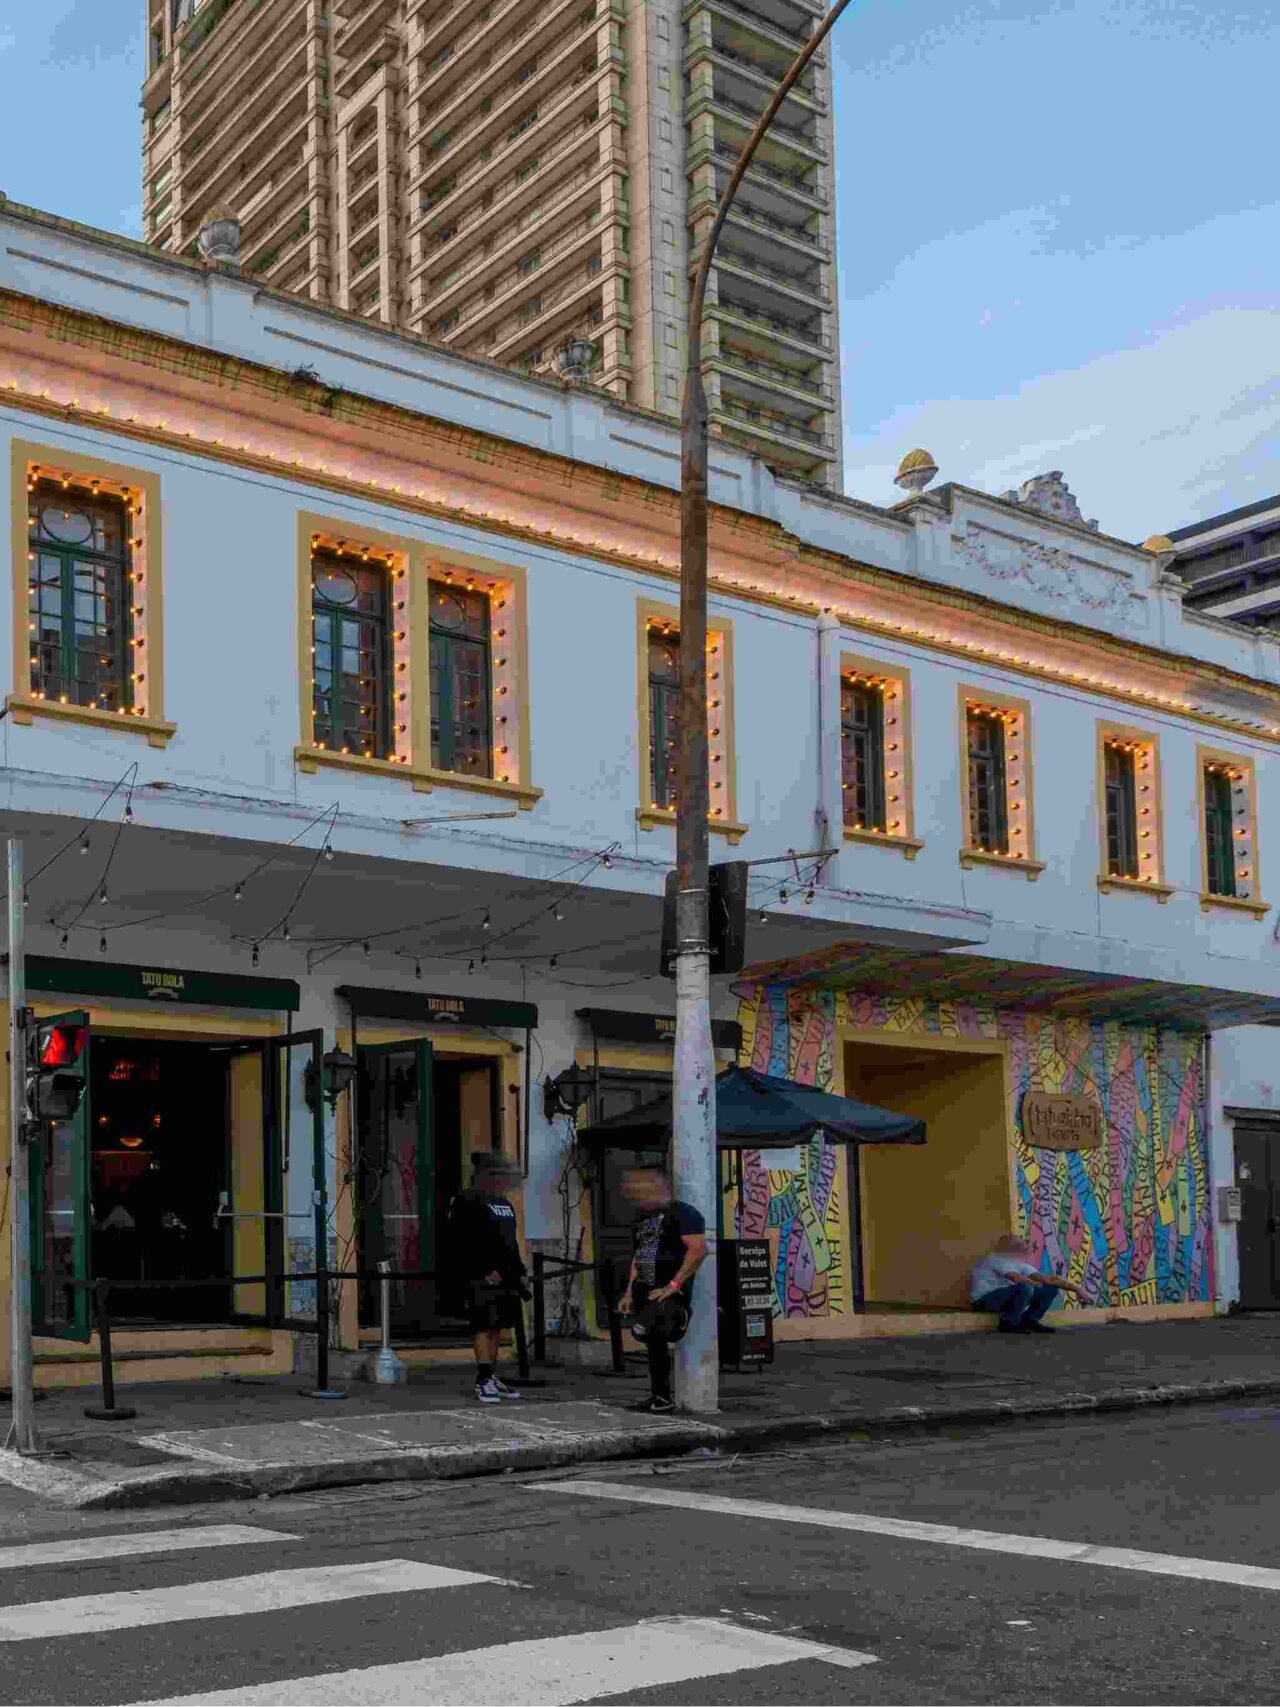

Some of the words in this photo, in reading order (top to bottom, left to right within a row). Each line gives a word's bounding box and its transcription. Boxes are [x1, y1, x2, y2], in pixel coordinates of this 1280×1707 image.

[141, 971, 162, 986] TATU
[162, 974, 185, 989] BOLA
[487, 1203, 514, 1217] VANS
[739, 1246, 767, 1256] Serviço
[750, 1259, 768, 1268] Valet
